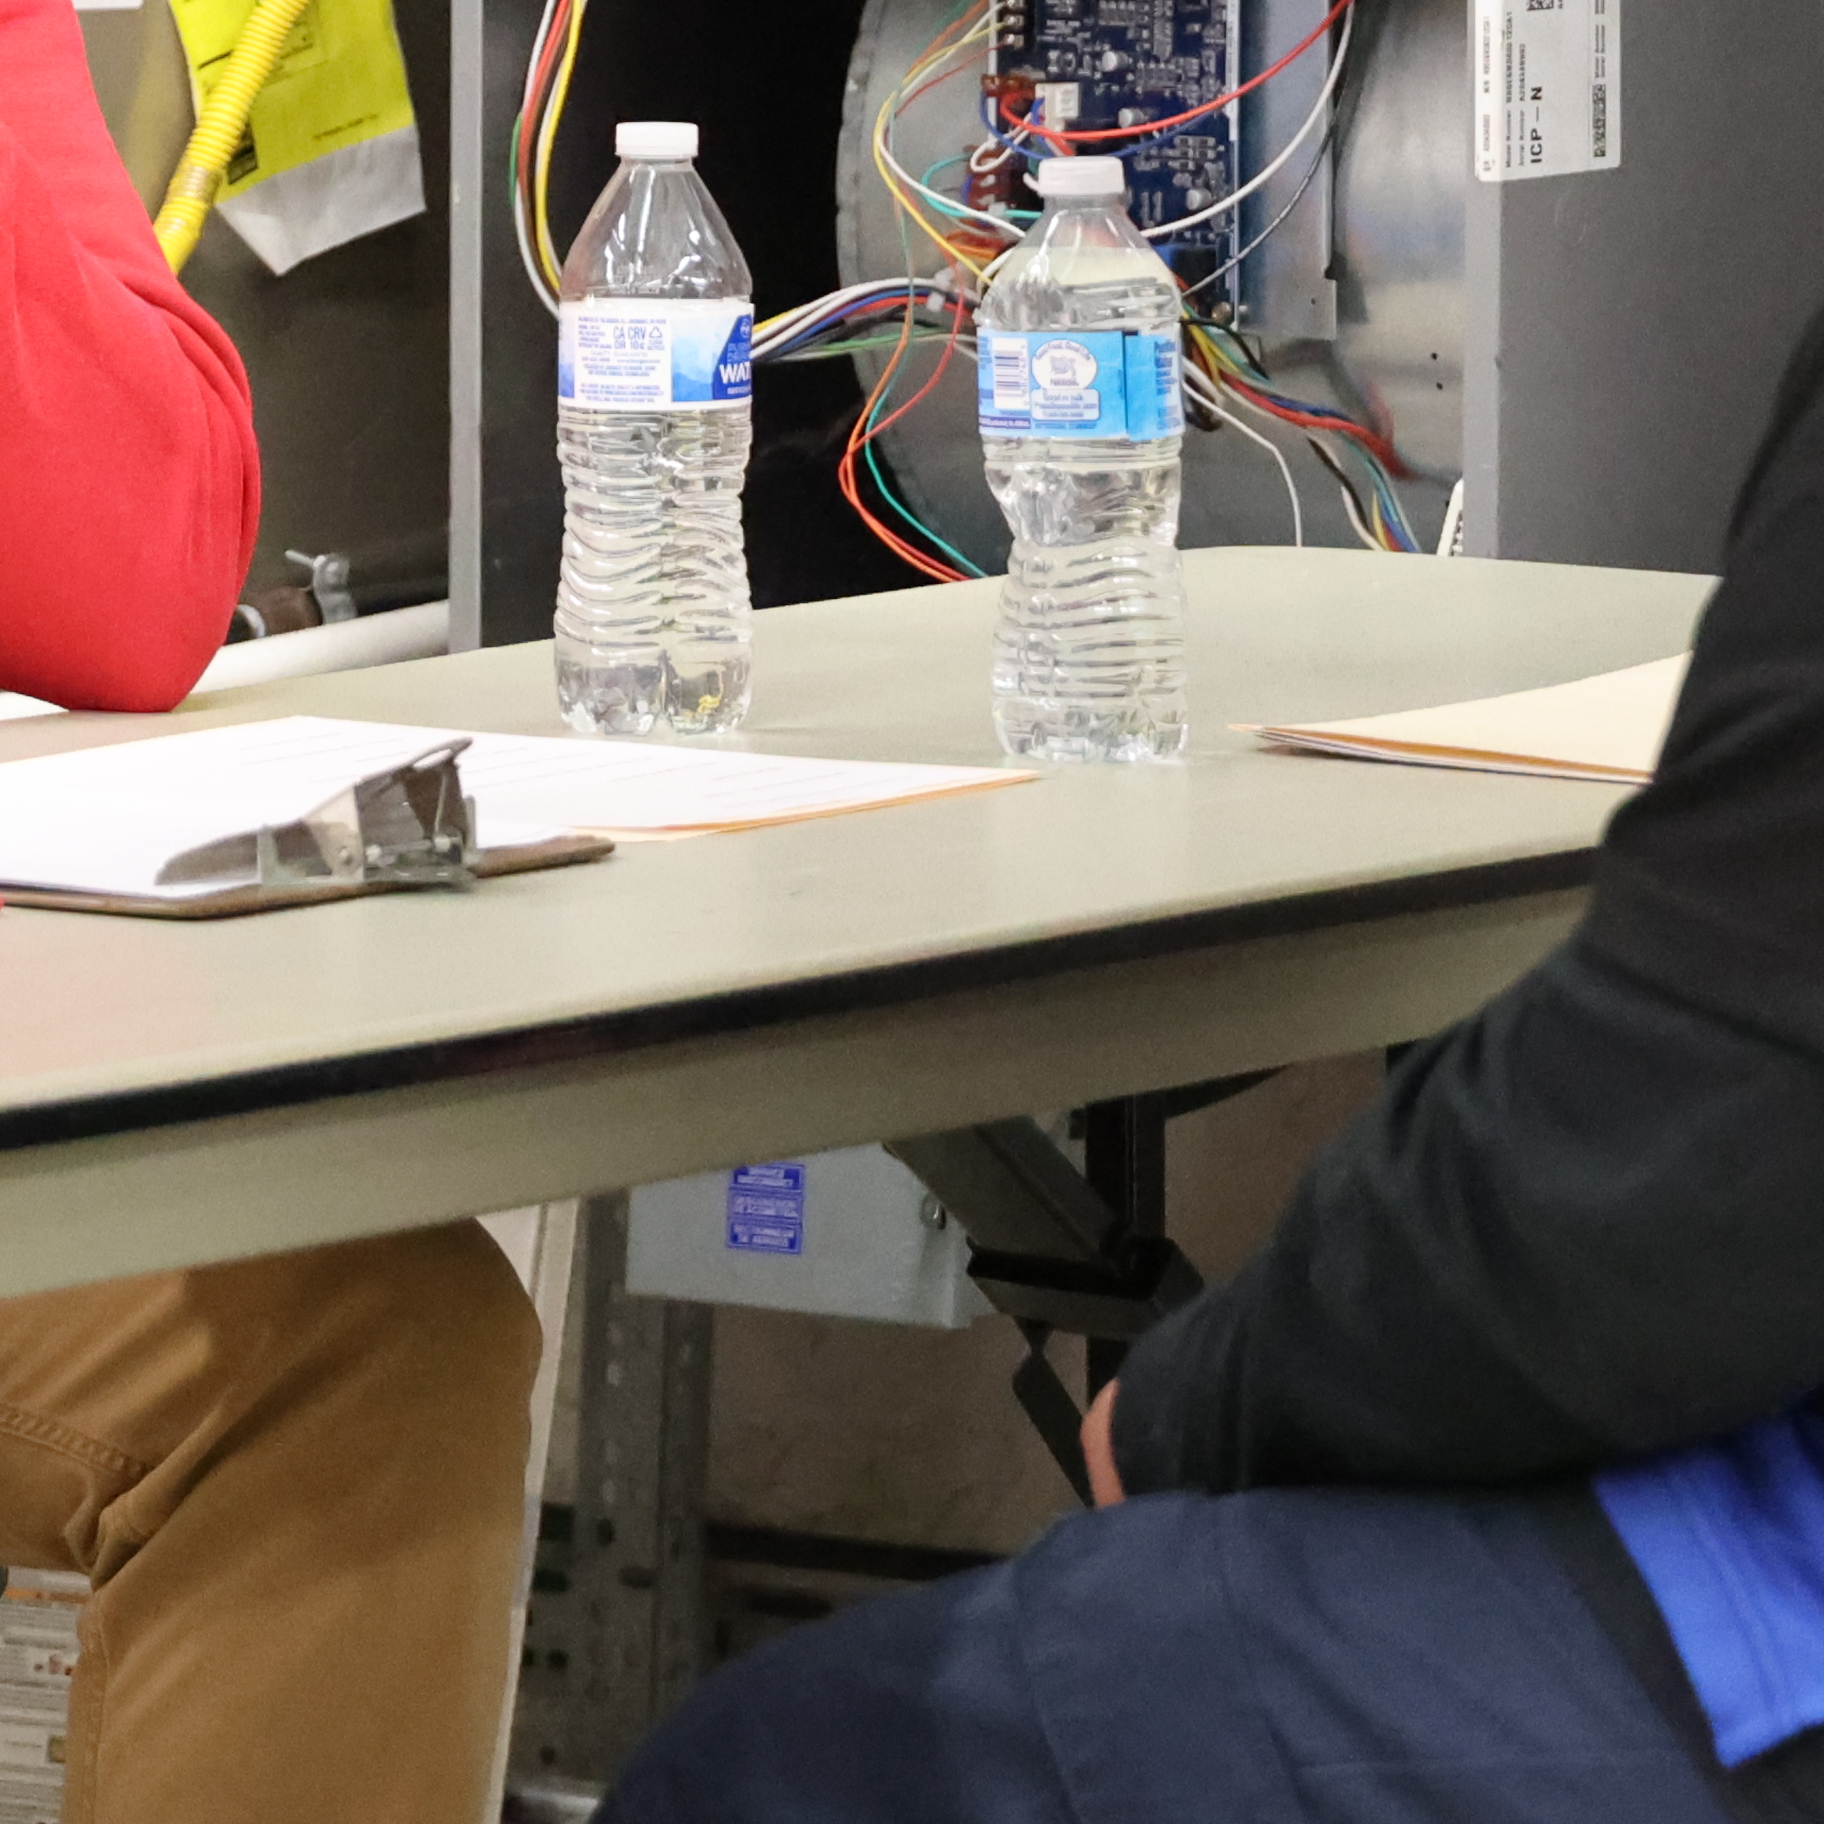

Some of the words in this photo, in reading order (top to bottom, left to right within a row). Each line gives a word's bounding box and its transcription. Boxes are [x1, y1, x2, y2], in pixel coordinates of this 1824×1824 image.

[1529, 128, 1543, 164] ICP
[613, 326, 625, 340] CA
[628, 327, 647, 340] CRV
